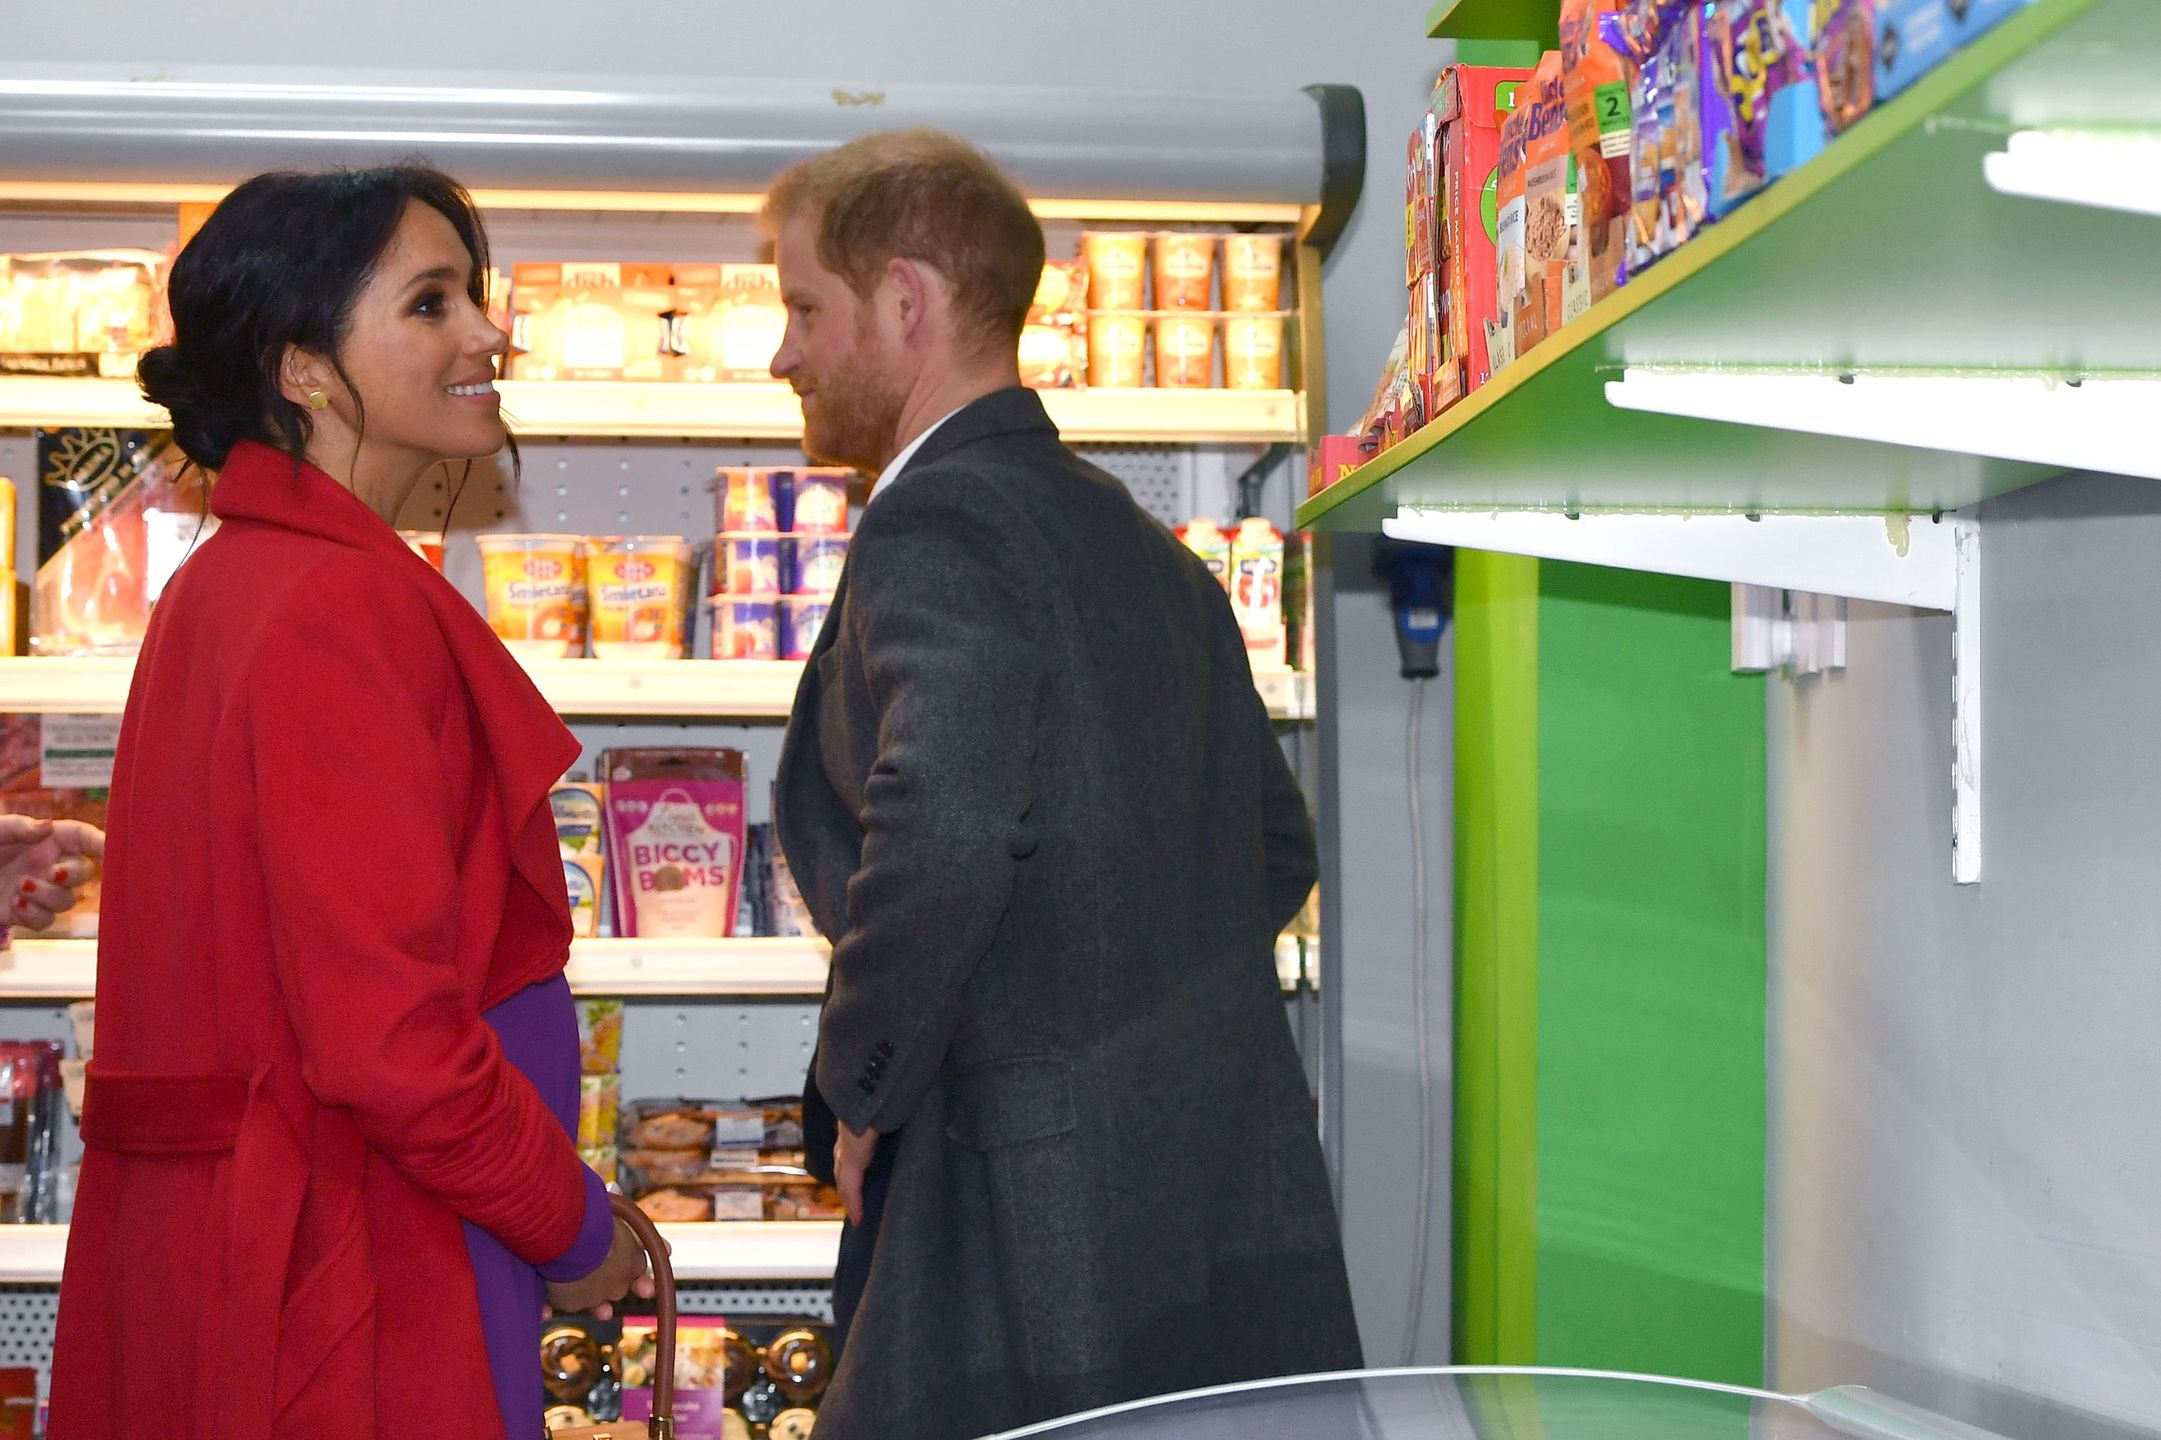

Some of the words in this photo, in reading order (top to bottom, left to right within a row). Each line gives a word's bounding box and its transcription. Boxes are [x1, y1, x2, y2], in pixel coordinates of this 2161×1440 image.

[1605, 96, 1621, 117] 2
[635, 842, 720, 866] BICCY
[639, 866, 725, 892] BMS
